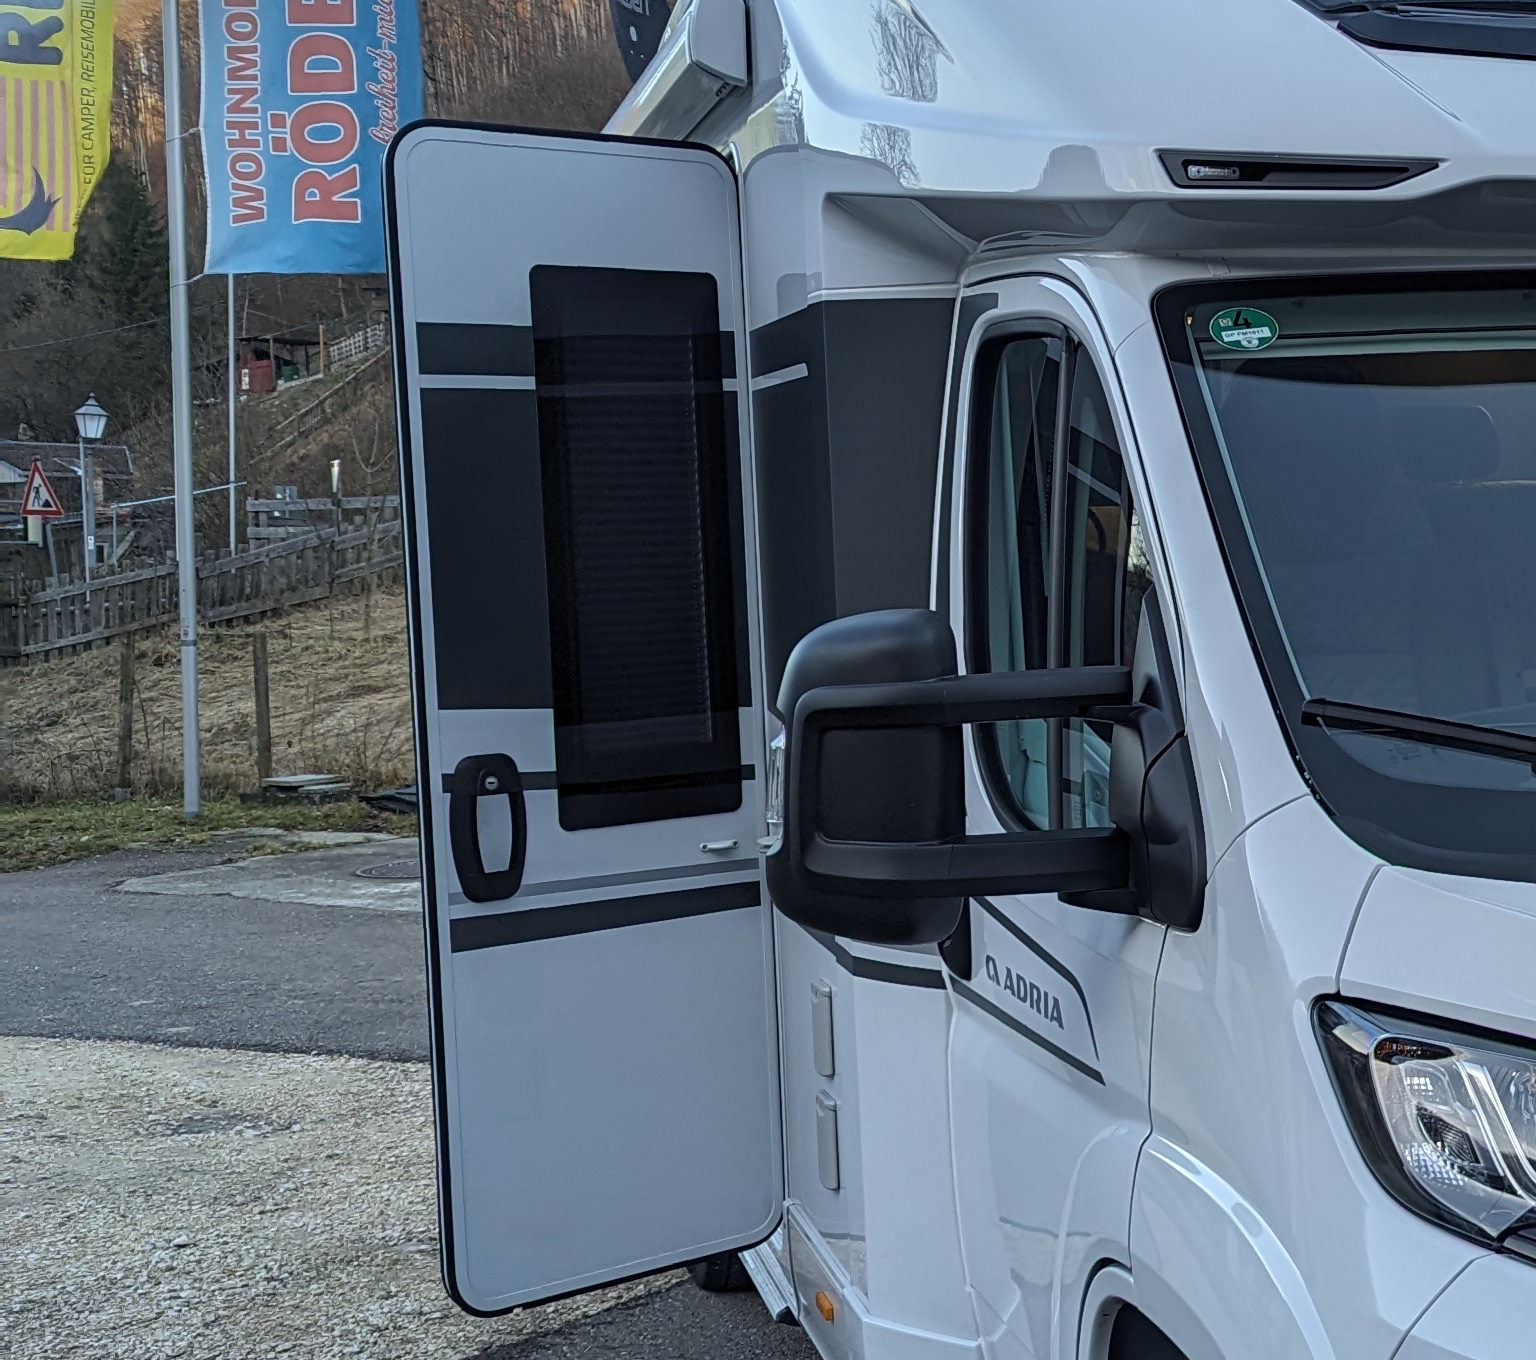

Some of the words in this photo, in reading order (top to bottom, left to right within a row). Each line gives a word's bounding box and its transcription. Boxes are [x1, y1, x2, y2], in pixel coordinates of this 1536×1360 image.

[80, 86, 97, 150] CAMPER,
[1233, 311, 1252, 328] 4
[1004, 966, 1064, 1030] ADRIA
